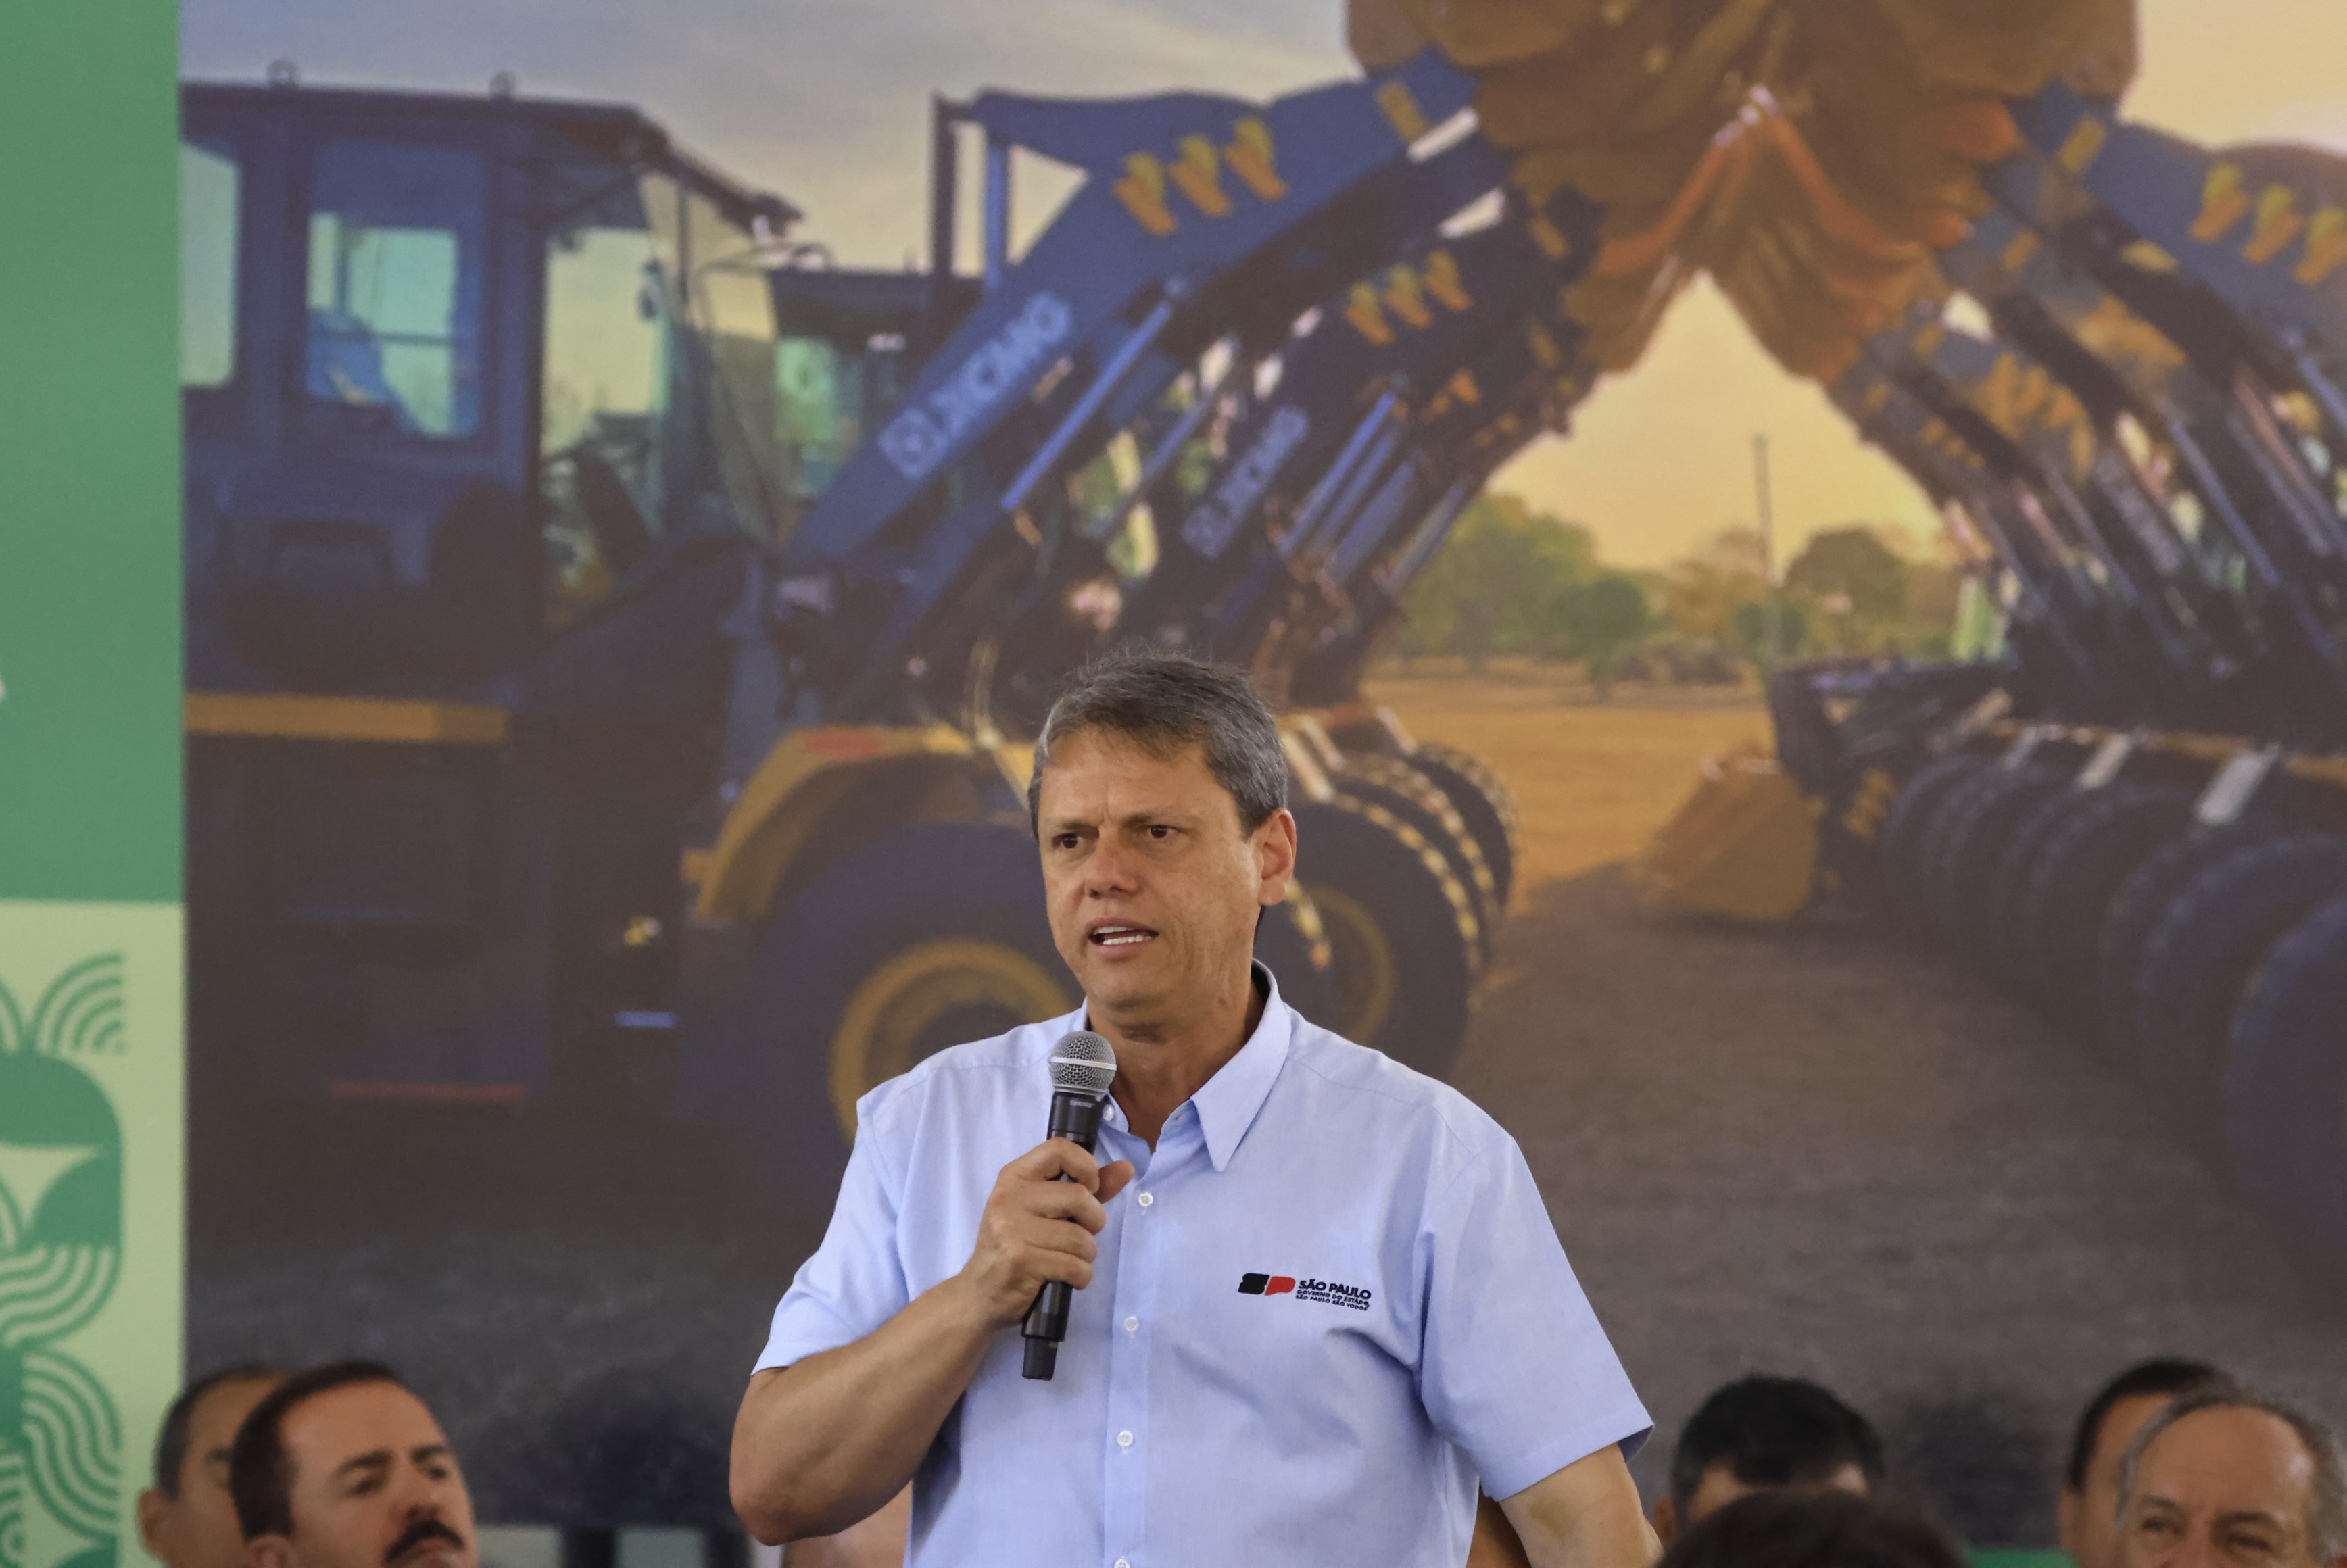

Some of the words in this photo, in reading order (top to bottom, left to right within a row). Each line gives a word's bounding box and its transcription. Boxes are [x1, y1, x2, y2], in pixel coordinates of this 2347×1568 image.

[1297, 1290, 1331, 1298] GOVERNO
[1298, 1279, 1327, 1291] SÃO
[1329, 1283, 1372, 1300] PAULO
[1347, 1302, 1368, 1311] TODOS
